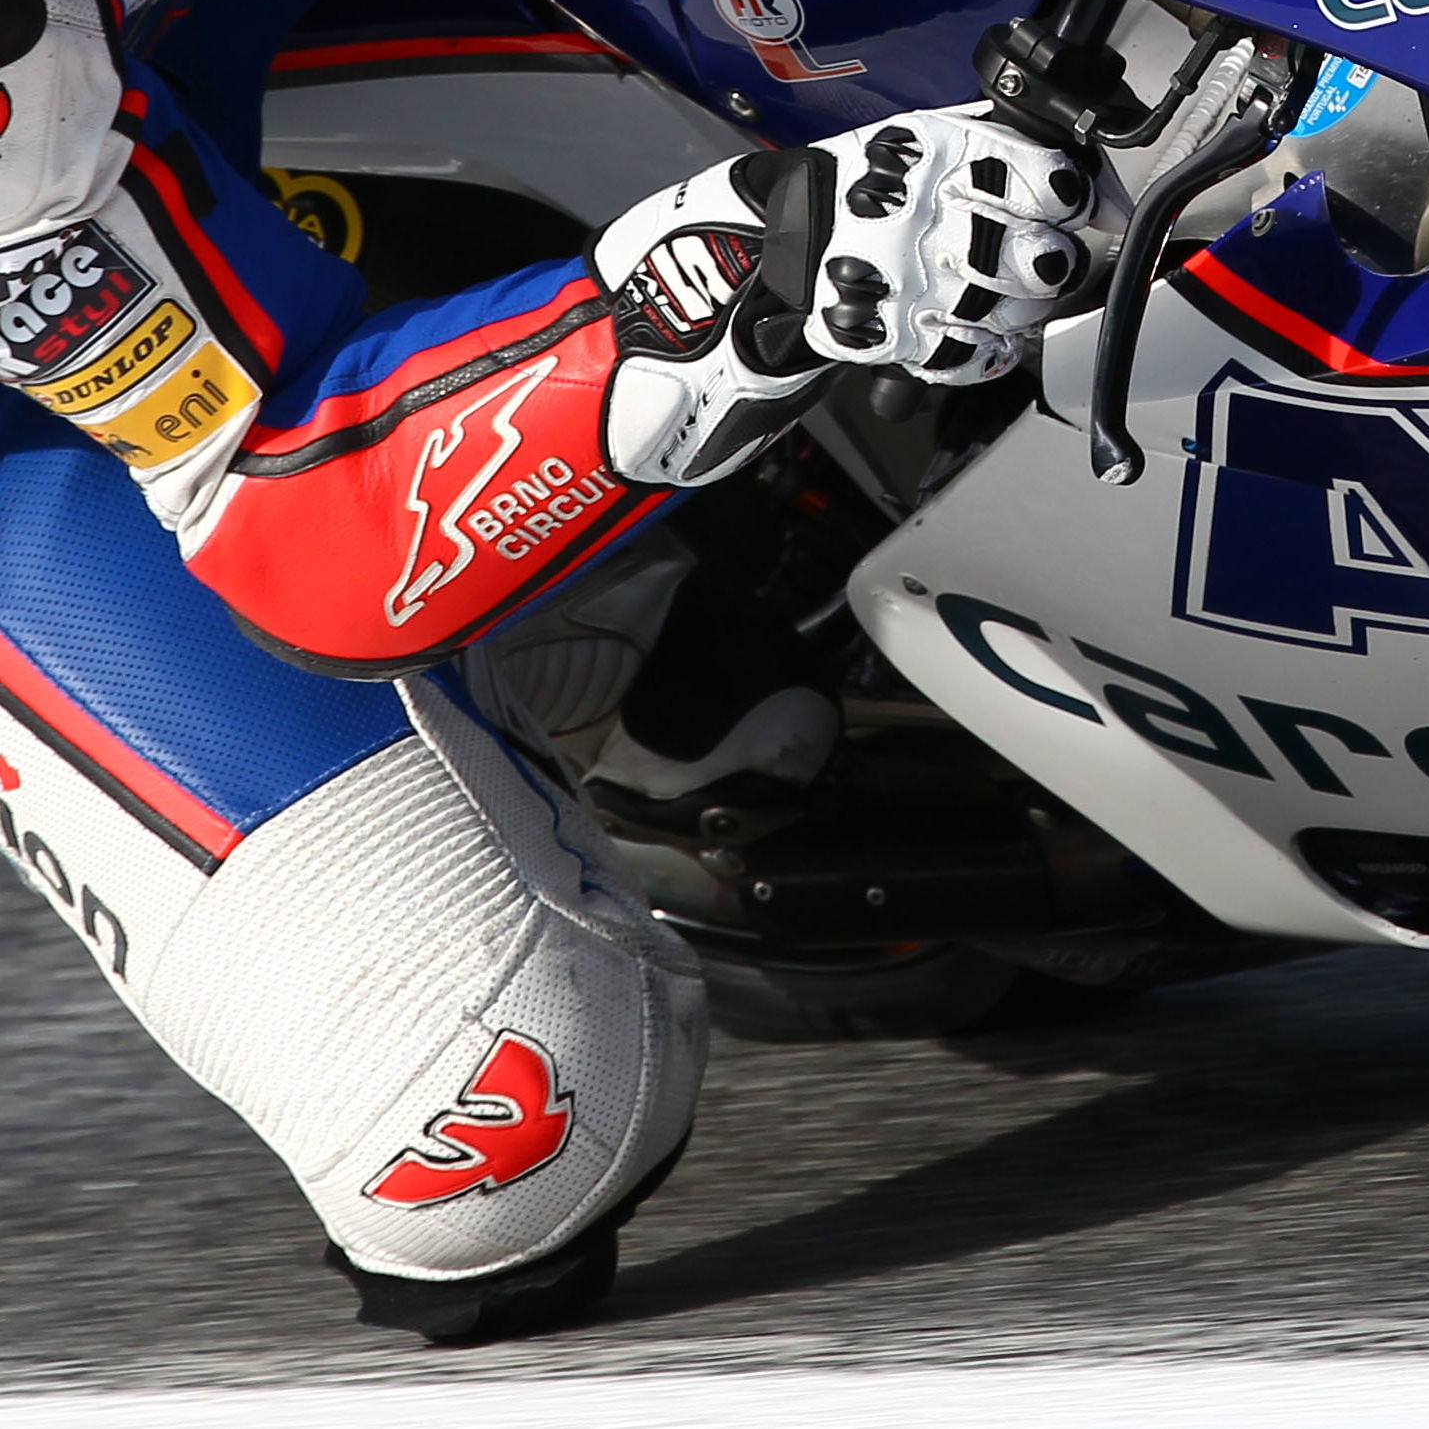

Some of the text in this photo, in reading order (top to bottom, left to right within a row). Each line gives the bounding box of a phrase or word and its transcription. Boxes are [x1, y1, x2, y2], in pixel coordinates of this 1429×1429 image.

[56, 315, 175, 406] DUNLOP
[154, 369, 229, 443] eni
[466, 456, 575, 543] BRNO
[494, 463, 618, 561] CIRCUI
